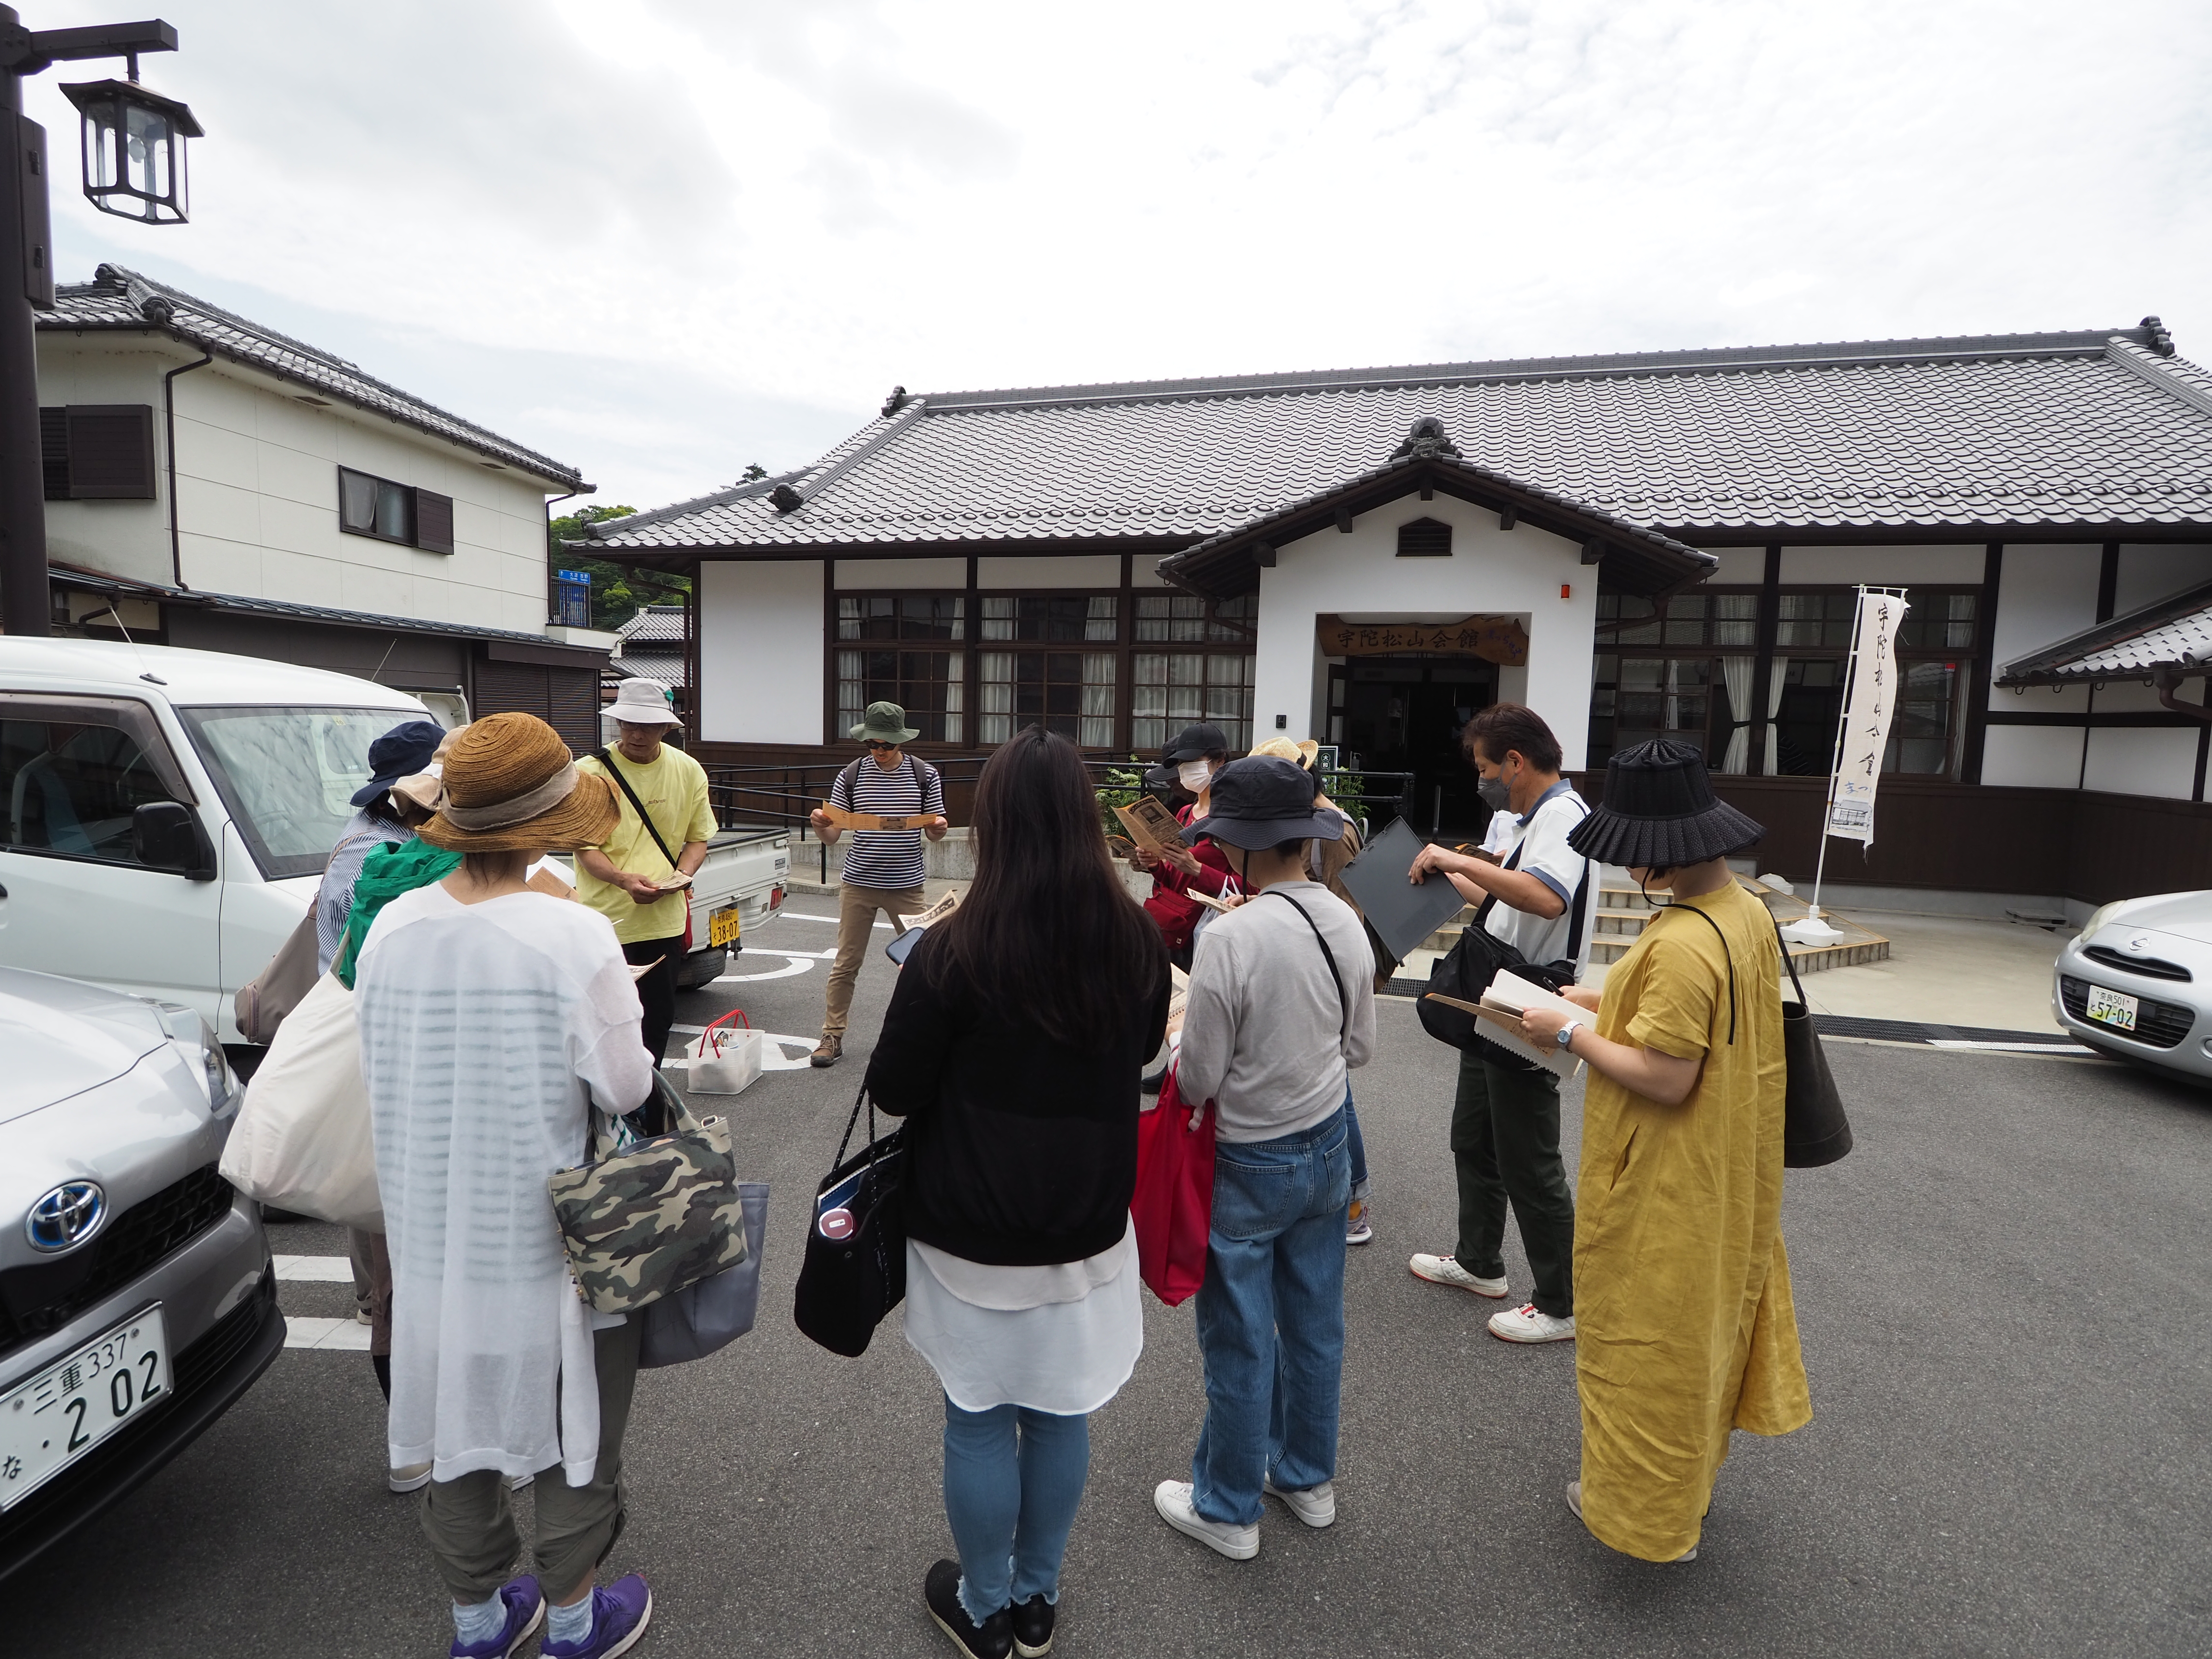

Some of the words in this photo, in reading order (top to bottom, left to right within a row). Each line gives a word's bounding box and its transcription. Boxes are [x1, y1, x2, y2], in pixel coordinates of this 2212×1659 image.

[1337, 629, 1479, 649] 宇陀松山会館
[717, 920, 737, 942] 38-07
[2090, 1003, 2095, 1012] と
[2097, 1001, 2133, 1027] 57-02
[2, 1455, 22, 1479] な
